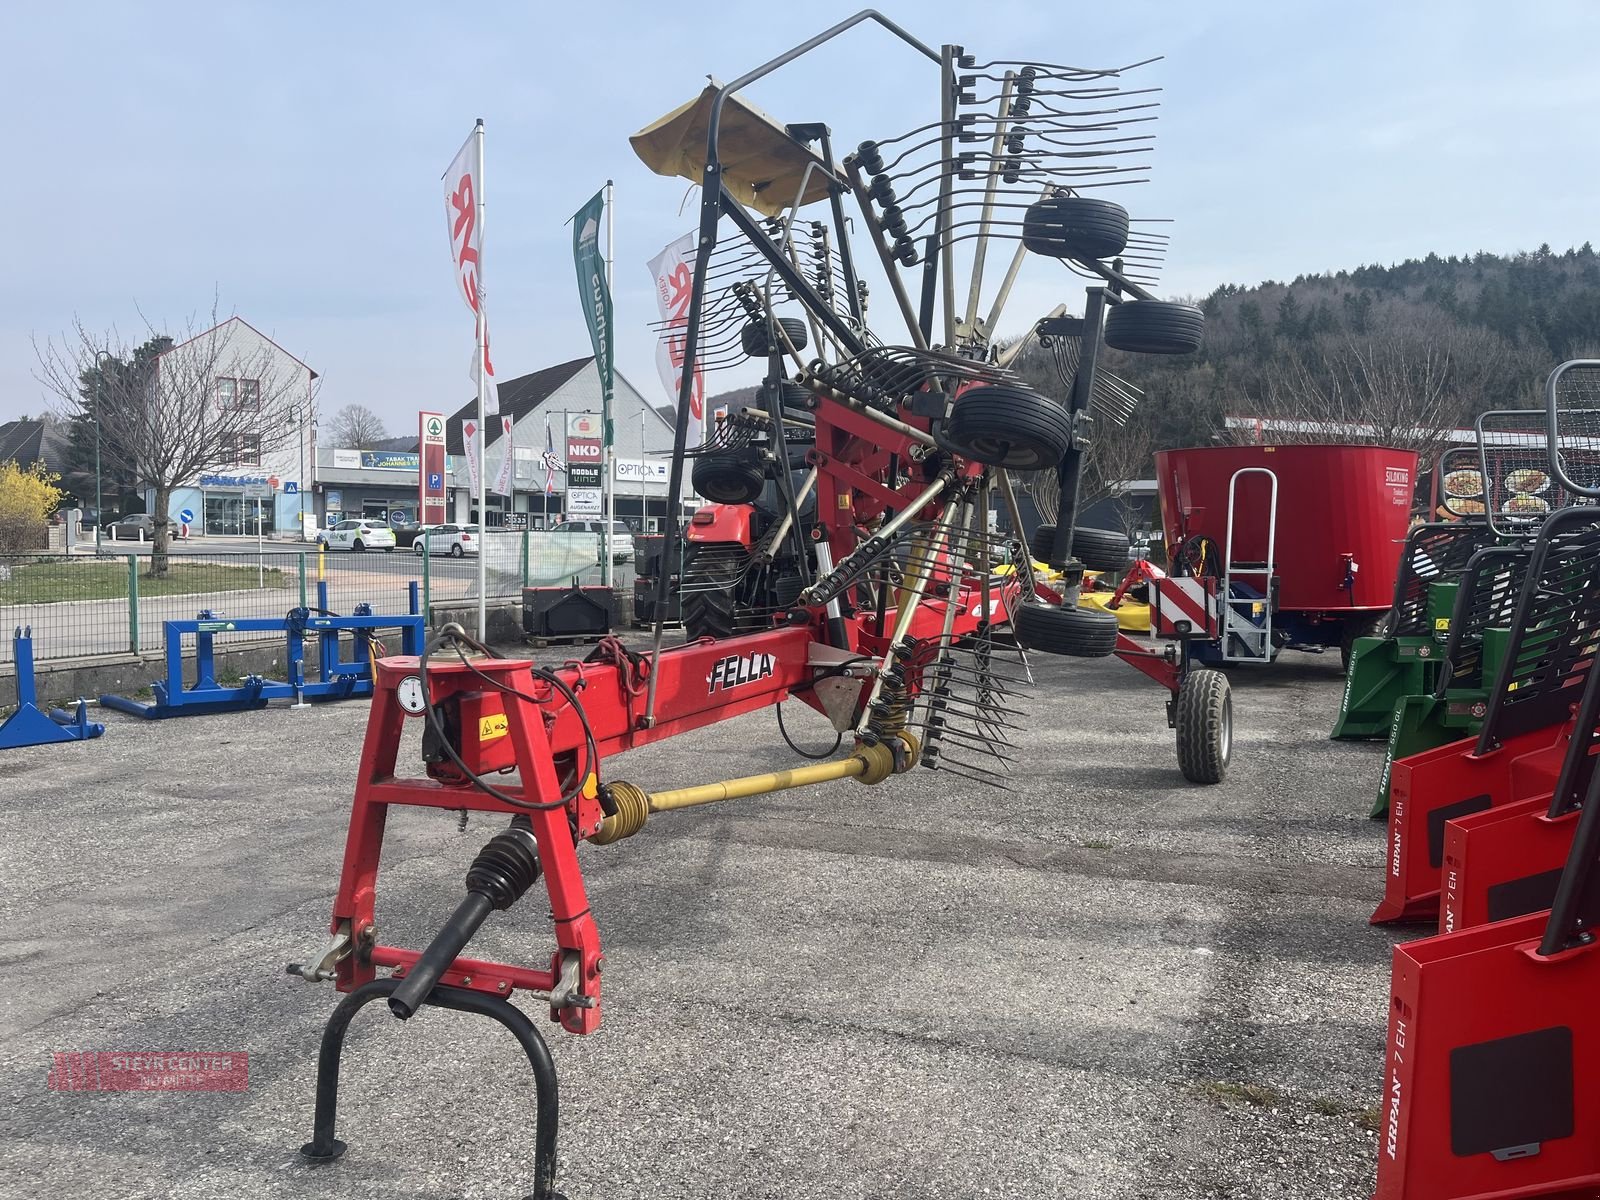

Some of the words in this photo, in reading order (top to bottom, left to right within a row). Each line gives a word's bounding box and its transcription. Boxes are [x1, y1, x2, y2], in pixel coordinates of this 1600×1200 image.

[569, 445, 600, 457] NKD
[617, 462, 656, 477] OPTICA
[1385, 470, 1409, 483] SILOKING
[432, 475, 439, 484] P
[571, 491, 599, 500] OPTICA
[707, 651, 775, 694] FELLA
[1379, 749, 1392, 796] KRPAN
[1389, 724, 1399, 745] 550
[1394, 708, 1402, 722] GL
[1395, 801, 1404, 817] EH
[1392, 831, 1402, 877] KRPAN
[1448, 871, 1457, 890] EH
[1447, 891, 1456, 901] 7
[1395, 1019, 1407, 1048] EH
[1394, 1051, 1404, 1064] 7
[1386, 1074, 1402, 1160] KRPAN
